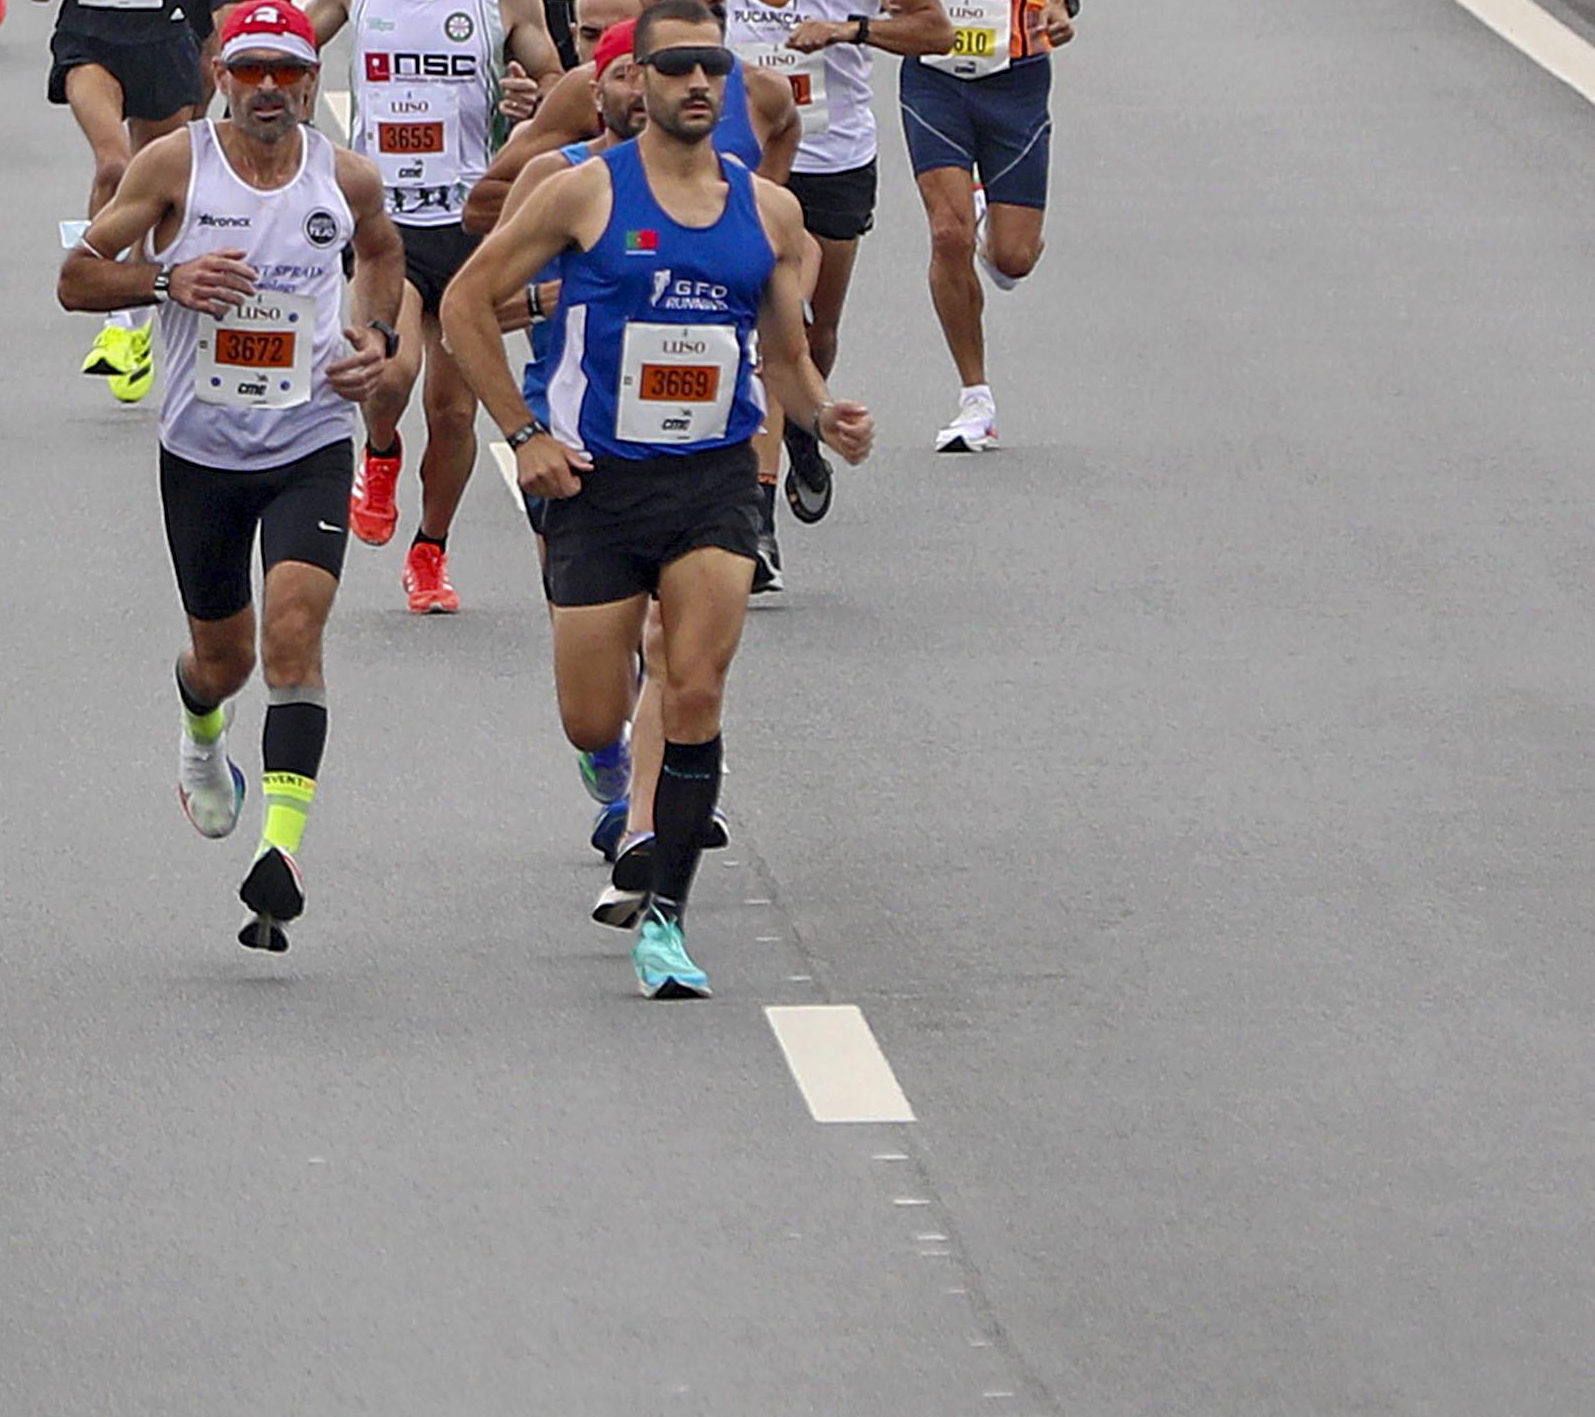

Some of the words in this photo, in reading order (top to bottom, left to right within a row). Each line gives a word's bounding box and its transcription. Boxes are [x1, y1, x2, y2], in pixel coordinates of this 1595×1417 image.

[953, 30, 988, 54] 610
[390, 101, 429, 113] LUSO
[387, 126, 435, 149] 3655
[237, 306, 281, 321] LUSO
[226, 334, 284, 363] 3672
[662, 340, 706, 354] LUSO
[650, 370, 710, 397] 3669
